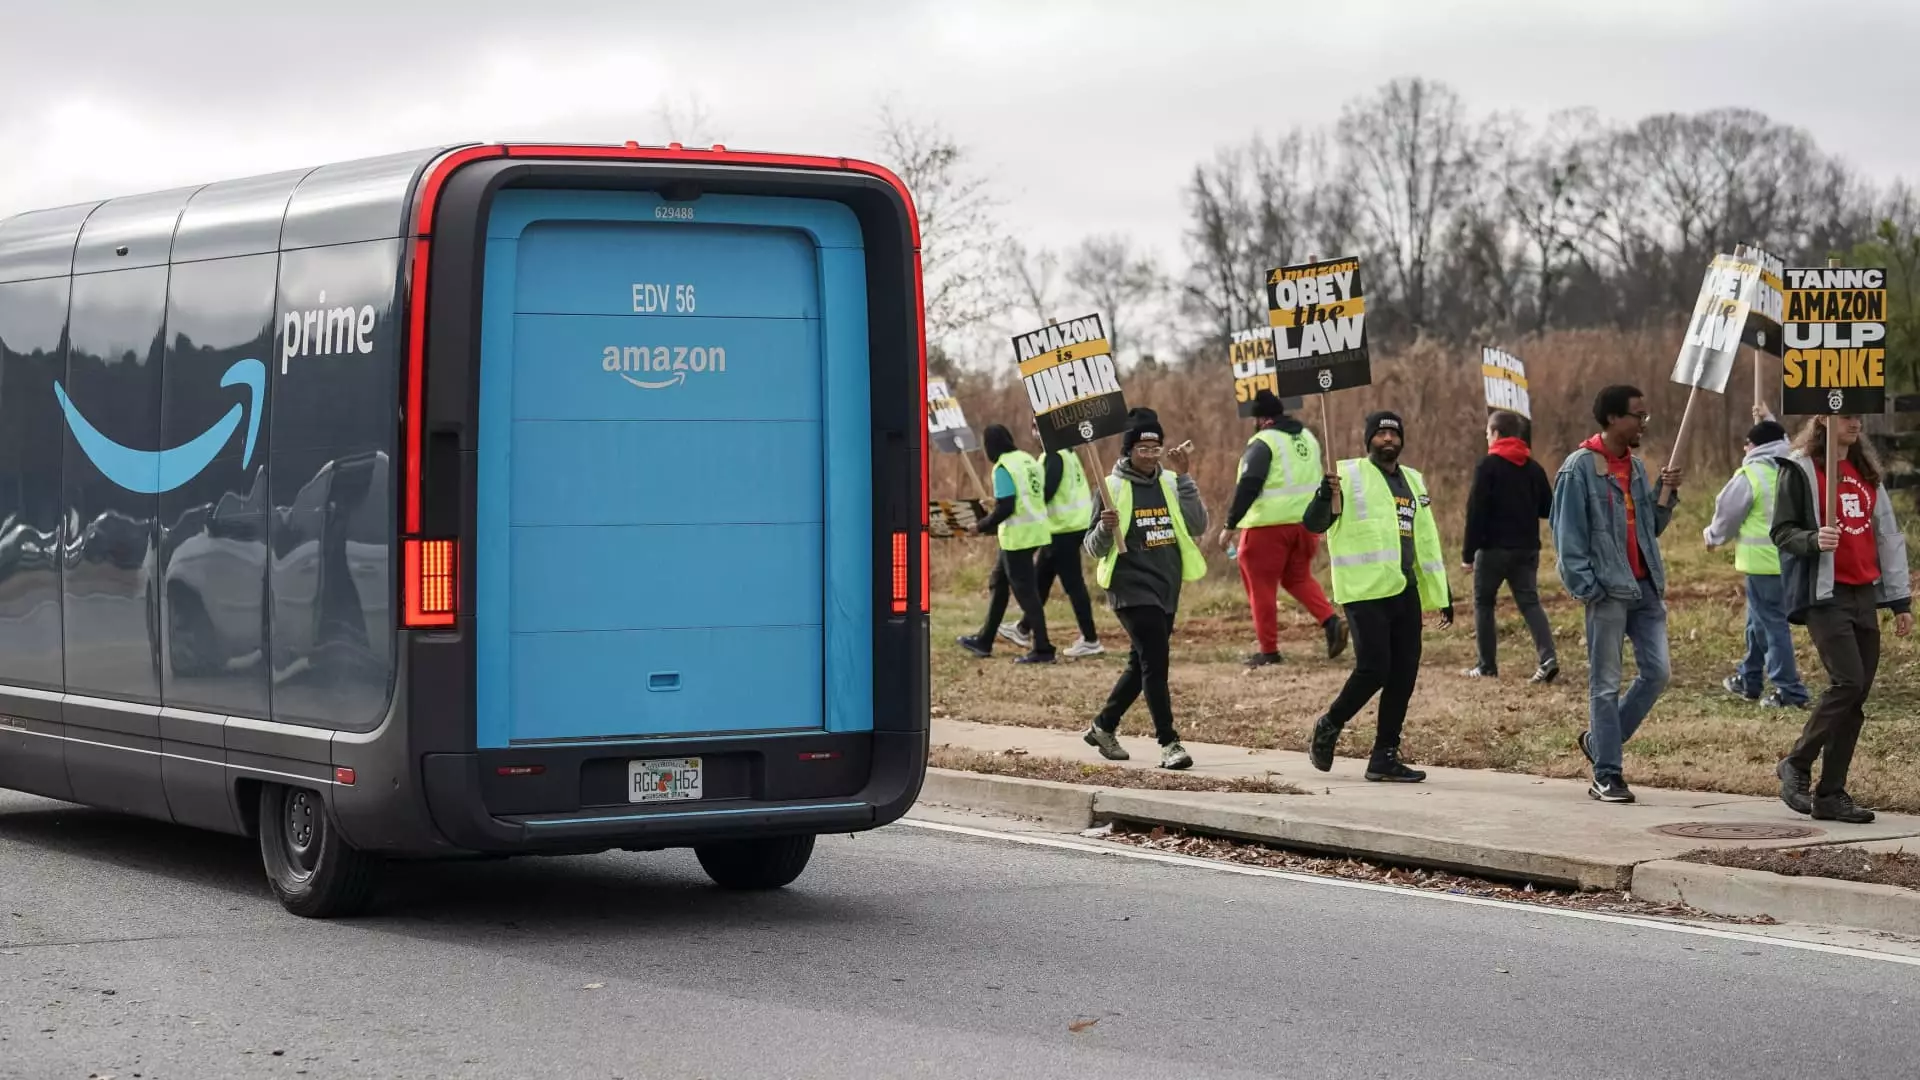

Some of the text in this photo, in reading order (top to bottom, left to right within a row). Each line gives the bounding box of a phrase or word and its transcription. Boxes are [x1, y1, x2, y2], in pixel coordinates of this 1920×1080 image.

[655, 206, 694, 219] 629488
[1269, 262, 1360, 284] Amazon:
[1787, 269, 1883, 289] TANNC
[632, 283, 695, 313] EDV 56
[1276, 270, 1354, 310] OBEY
[1290, 304, 1345, 326] the
[1788, 291, 1882, 321] AMAZON
[282, 290, 375, 375] prime
[1019, 316, 1101, 361] AMAZON
[1274, 313, 1365, 360] LAW
[1784, 322, 1885, 349] ULP
[602, 346, 726, 372] amazon
[1056, 349, 1073, 363] is
[1236, 339, 1274, 361] AMAZ
[1483, 347, 1525, 378] AMAZON
[1233, 358, 1276, 379] UL
[1784, 348, 1885, 389] STRIKE
[1023, 354, 1121, 414] UNFAIR
[1484, 376, 1531, 419] UNFAIR
[1050, 397, 1110, 430] INJUSTO
[634, 769, 699, 792] RGG H62
